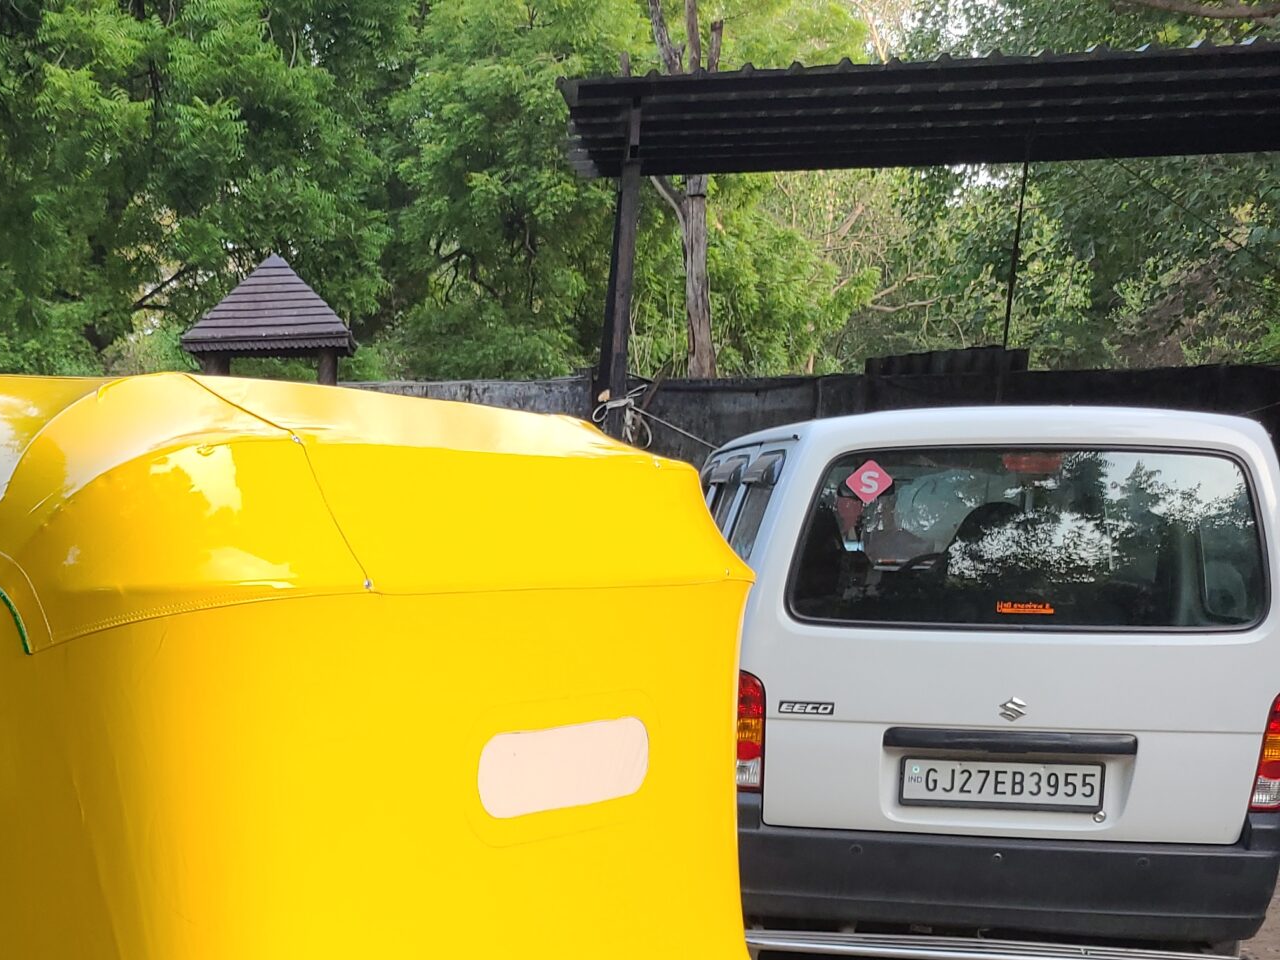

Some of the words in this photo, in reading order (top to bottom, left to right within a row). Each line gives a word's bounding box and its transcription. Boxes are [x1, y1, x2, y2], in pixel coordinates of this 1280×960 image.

[860, 471, 879, 494] S
[779, 702, 833, 714] EECO
[925, 767, 1096, 798] GJ27EB3955
